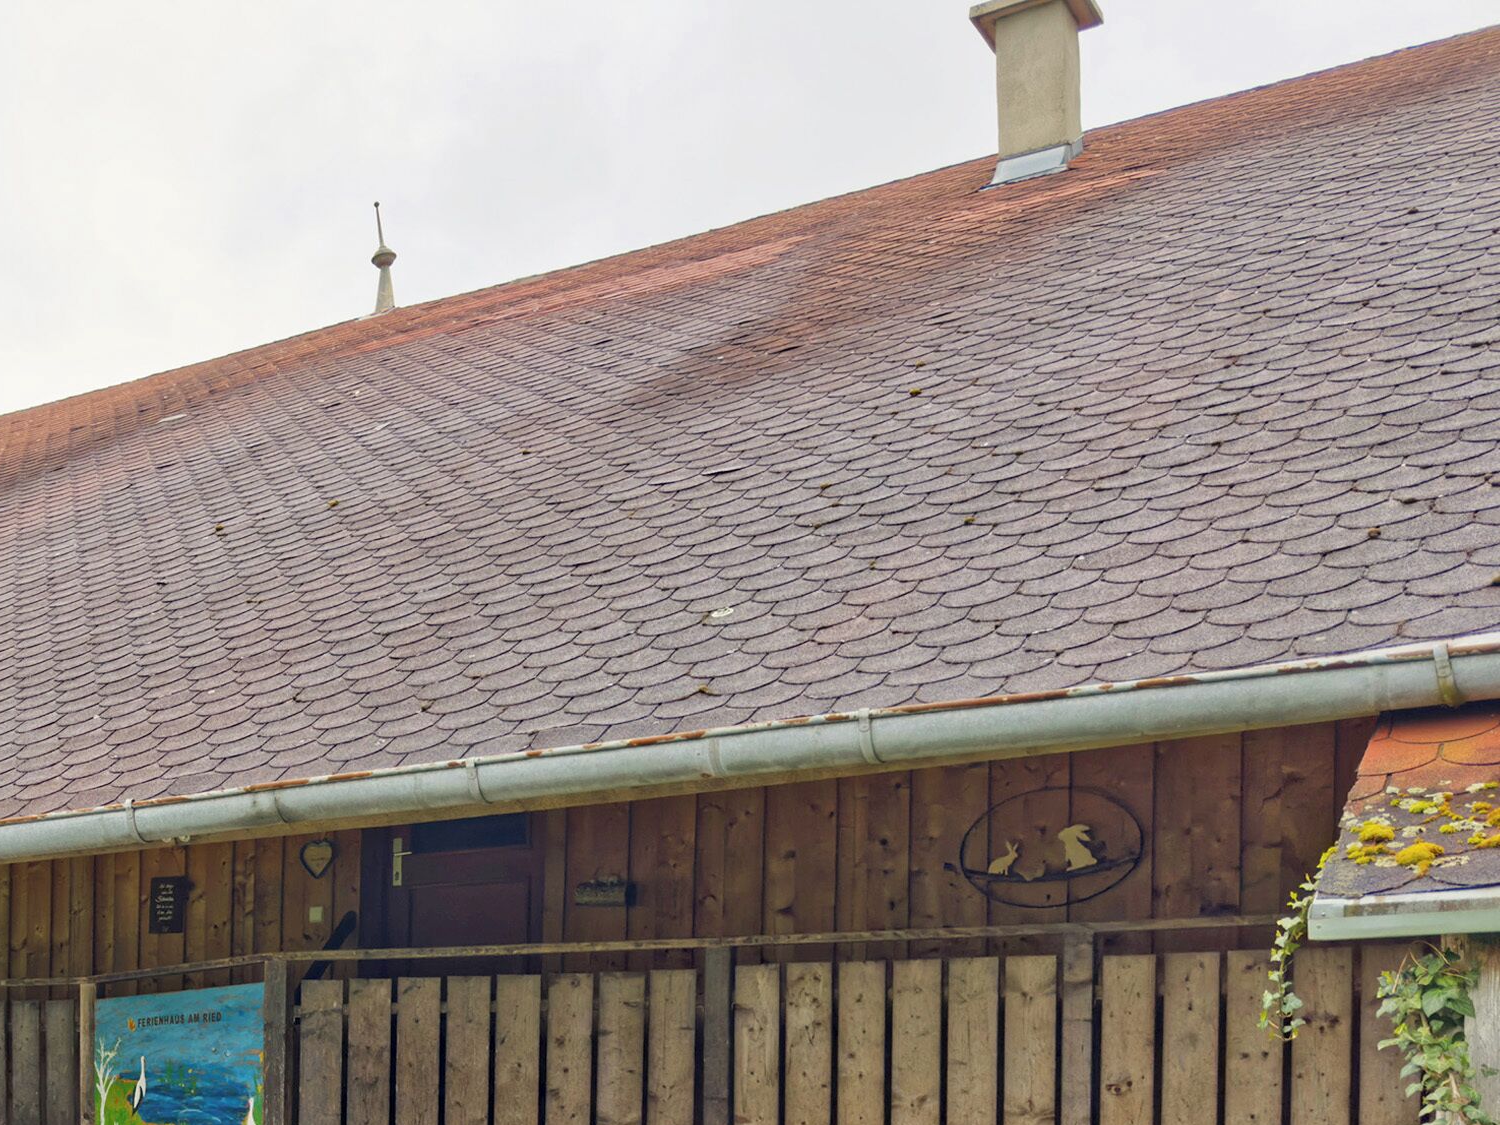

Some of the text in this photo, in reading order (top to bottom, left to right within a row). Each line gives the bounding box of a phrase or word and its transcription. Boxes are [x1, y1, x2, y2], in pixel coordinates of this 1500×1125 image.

[137, 1011, 222, 1028] FERIENHAUS AM RIED
